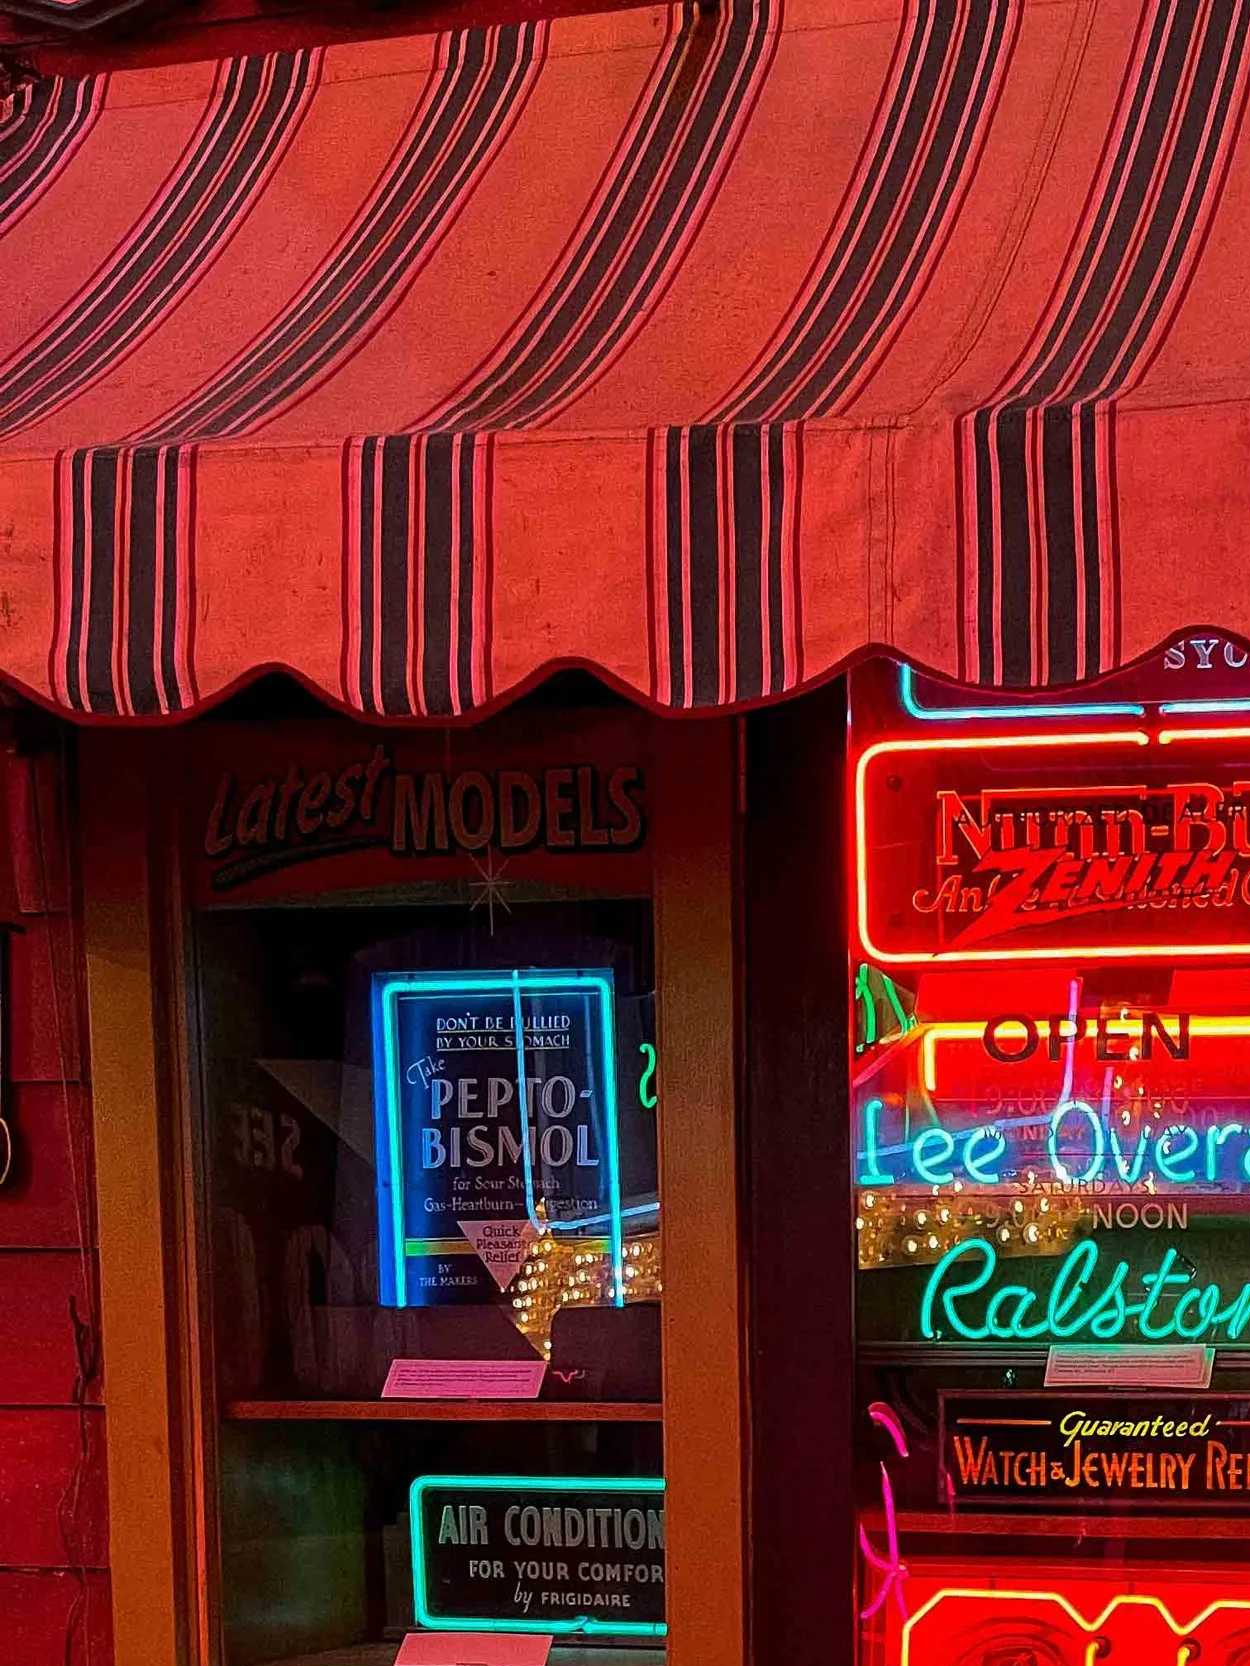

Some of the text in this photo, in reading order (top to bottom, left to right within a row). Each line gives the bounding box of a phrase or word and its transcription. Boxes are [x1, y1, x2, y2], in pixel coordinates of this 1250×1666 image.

[204, 744, 646, 857] Latest MODELS
[935, 846, 1238, 957] ZENITH
[436, 1012, 477, 1031] DON'T
[485, 1016, 504, 1030] BE
[436, 1034, 570, 1049] BY YOUR SOMACH
[983, 1012, 1190, 1064] OPEN
[406, 1055, 447, 1089] Take
[421, 1124, 600, 1170] BISMOL
[858, 1099, 1007, 1186] Lee
[452, 1176, 471, 1191] for
[475, 1176, 503, 1191] Sour
[1092, 1202, 1188, 1229] NOON
[476, 1239, 528, 1250] Pleasant
[482, 1225, 521, 1238] Quick
[438, 1264, 452, 1274] BY
[484, 1252, 521, 1263] Relief
[419, 1276, 479, 1286] THE MAKERS
[1059, 1410, 1212, 1448] Guaranteed
[953, 1436, 1046, 1486] WATCH
[1065, 1440, 1196, 1490] JEWELRY
[438, 1505, 666, 1550] AIR CONDITION
[469, 1560, 505, 1578] FOR
[513, 1561, 570, 1581] YOUR
[514, 1581, 631, 1613] by FRIGIDAIRE
